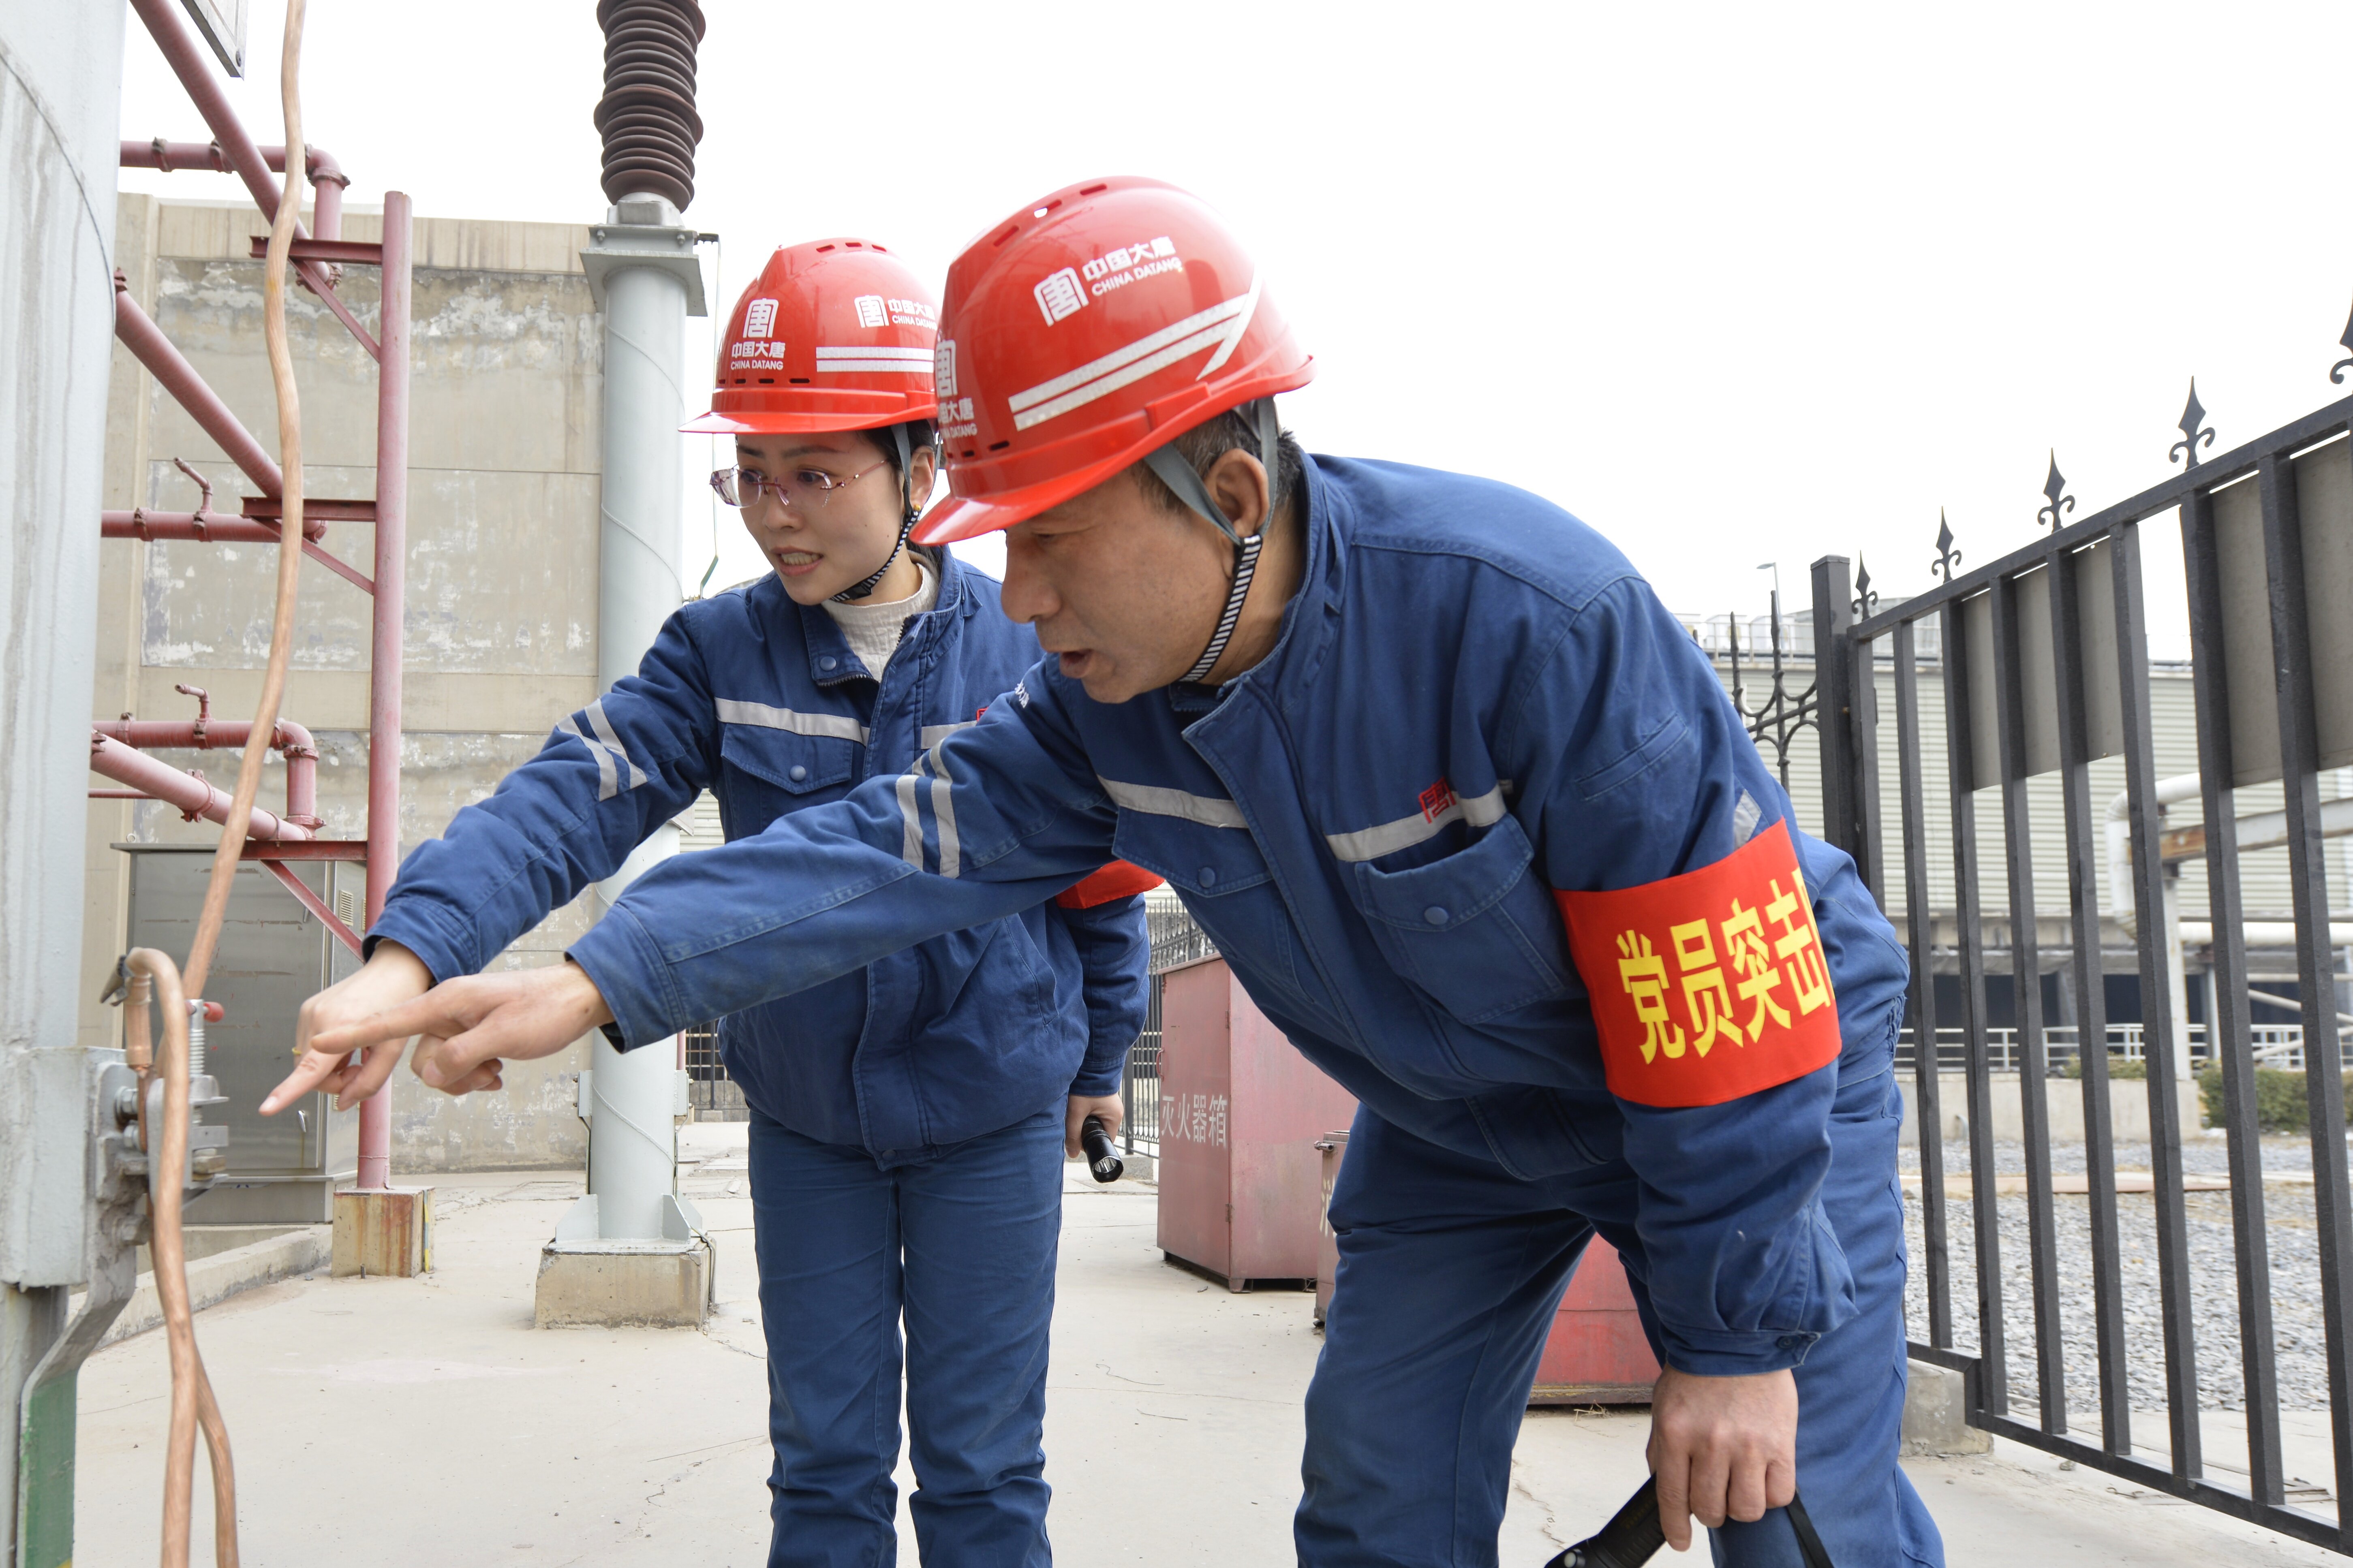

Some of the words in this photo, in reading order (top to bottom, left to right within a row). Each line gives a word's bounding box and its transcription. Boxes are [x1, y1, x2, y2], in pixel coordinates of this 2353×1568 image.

[1082, 236, 1176, 282] 中国大唐
[1091, 271, 1134, 296] CHINA
[1133, 257, 1182, 280] DATANG
[892, 315, 916, 325] CHINA
[915, 317, 938, 331] DATANG
[731, 360, 750, 370] CHINA
[752, 360, 783, 370] DATANG
[732, 341, 785, 359] 中国大唐
[1616, 866, 1835, 1065] 党员突击
[1161, 1093, 1228, 1149] 灭火器箱
